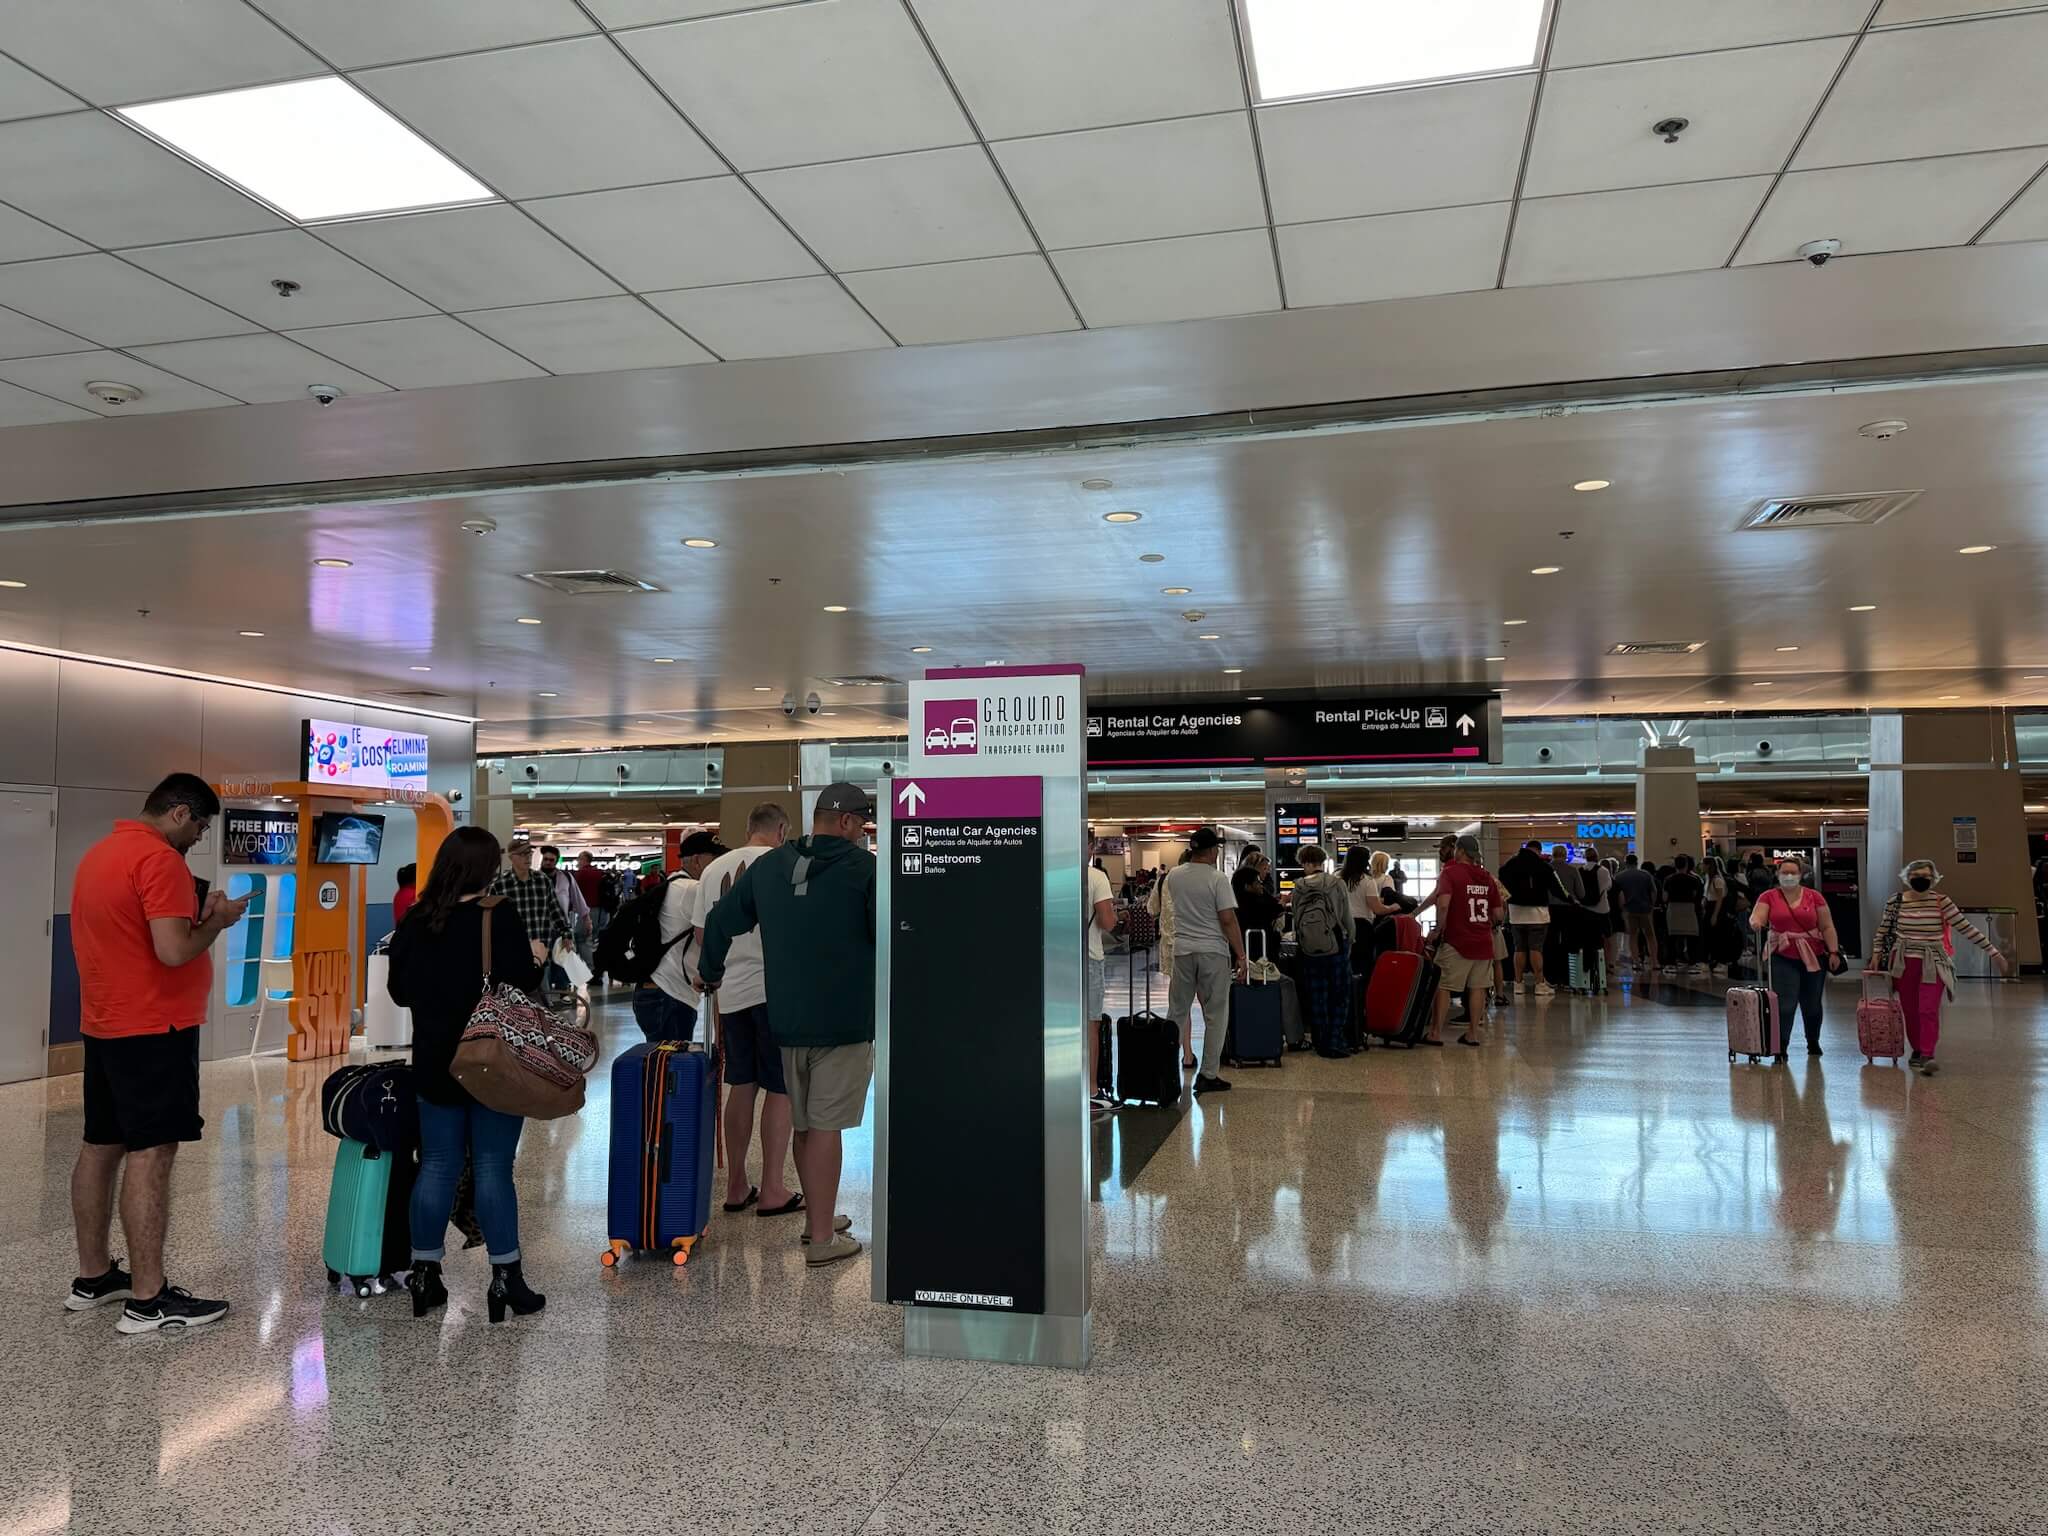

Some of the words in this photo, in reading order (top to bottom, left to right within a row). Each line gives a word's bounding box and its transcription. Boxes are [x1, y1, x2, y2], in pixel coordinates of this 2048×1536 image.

[984, 695, 1065, 722] GROUND
[1108, 716, 1148, 728] Rental
[1152, 716, 1176, 727] Car
[1180, 714, 1241, 728] Agencies
[1316, 710, 1360, 723] Rental
[1364, 708, 1420, 722] Pick-Up
[984, 724, 1065, 737] TRANSPORTATION
[1362, 723, 1388, 731] Entrega
[1107, 730, 1136, 738] Agencias
[984, 744, 1031, 755] TRANSPORTE
[1036, 744, 1065, 754] URBANO
[392, 760, 427, 772] ROAMIN
[230, 820, 262, 833] FREE
[924, 826, 959, 837] Rental
[962, 826, 982, 836] Car
[986, 825, 1038, 838] Agencies
[1577, 823, 1636, 839] ROYAL
[925, 839, 956, 847] Agencias
[967, 838, 992, 847] Alquiler
[993, 838, 1002, 846] de
[1003, 838, 1023, 846] Autos
[924, 854, 982, 864] Restrooms
[924, 866, 946, 874] Baños
[1468, 898, 1489, 922] 13
[303, 952, 351, 995] YOUR
[296, 994, 351, 1060] SIM
[916, 1291, 936, 1301] YOU
[938, 1292, 957, 1302] ARE
[960, 1294, 974, 1304] ON
[976, 1294, 1004, 1305] LEVEL
[1006, 1296, 1013, 1306] 4
